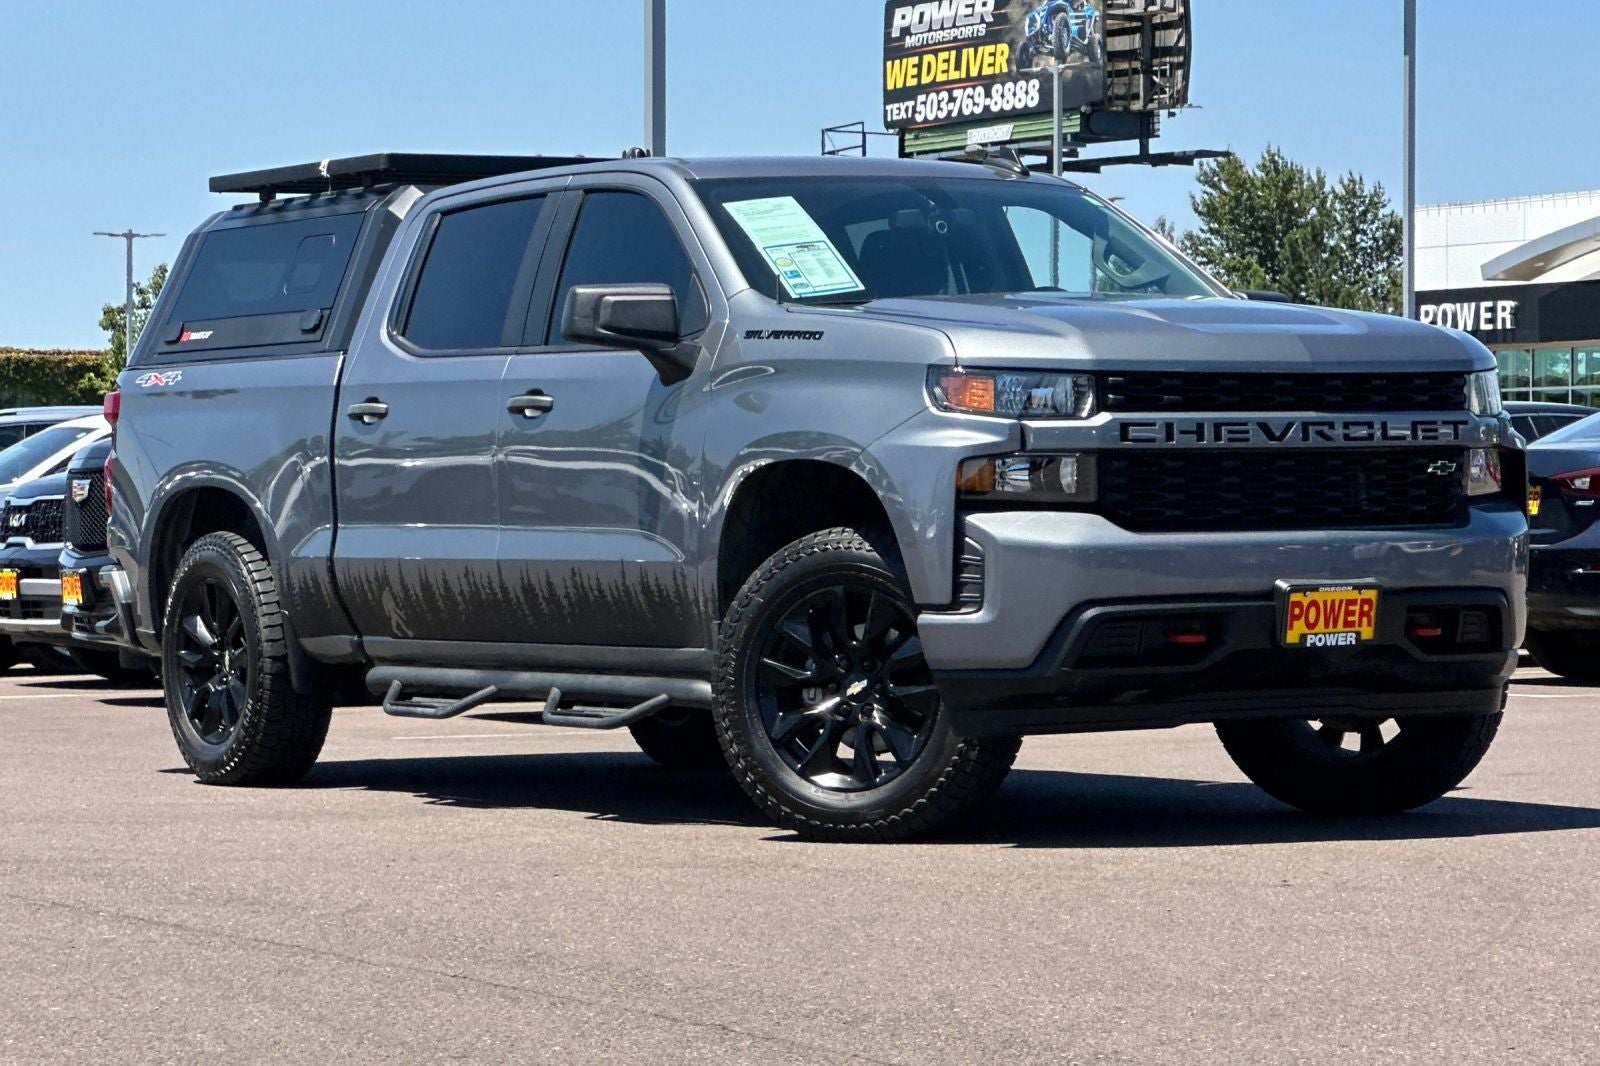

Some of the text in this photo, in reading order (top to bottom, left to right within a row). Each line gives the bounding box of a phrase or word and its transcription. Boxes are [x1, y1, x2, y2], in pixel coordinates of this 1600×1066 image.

[892, 0, 995, 37] POWER
[905, 24, 987, 48] MOTORSPORTS
[886, 43, 1010, 90] WE DELIVER
[885, 79, 1040, 123] TEXT 503-769-8888
[1420, 300, 1516, 332] POWER
[744, 330, 824, 341] SILVERADO
[1119, 420, 1469, 443] CHEVROLET
[1287, 598, 1374, 631] POWER
[1306, 632, 1357, 647] POWER
